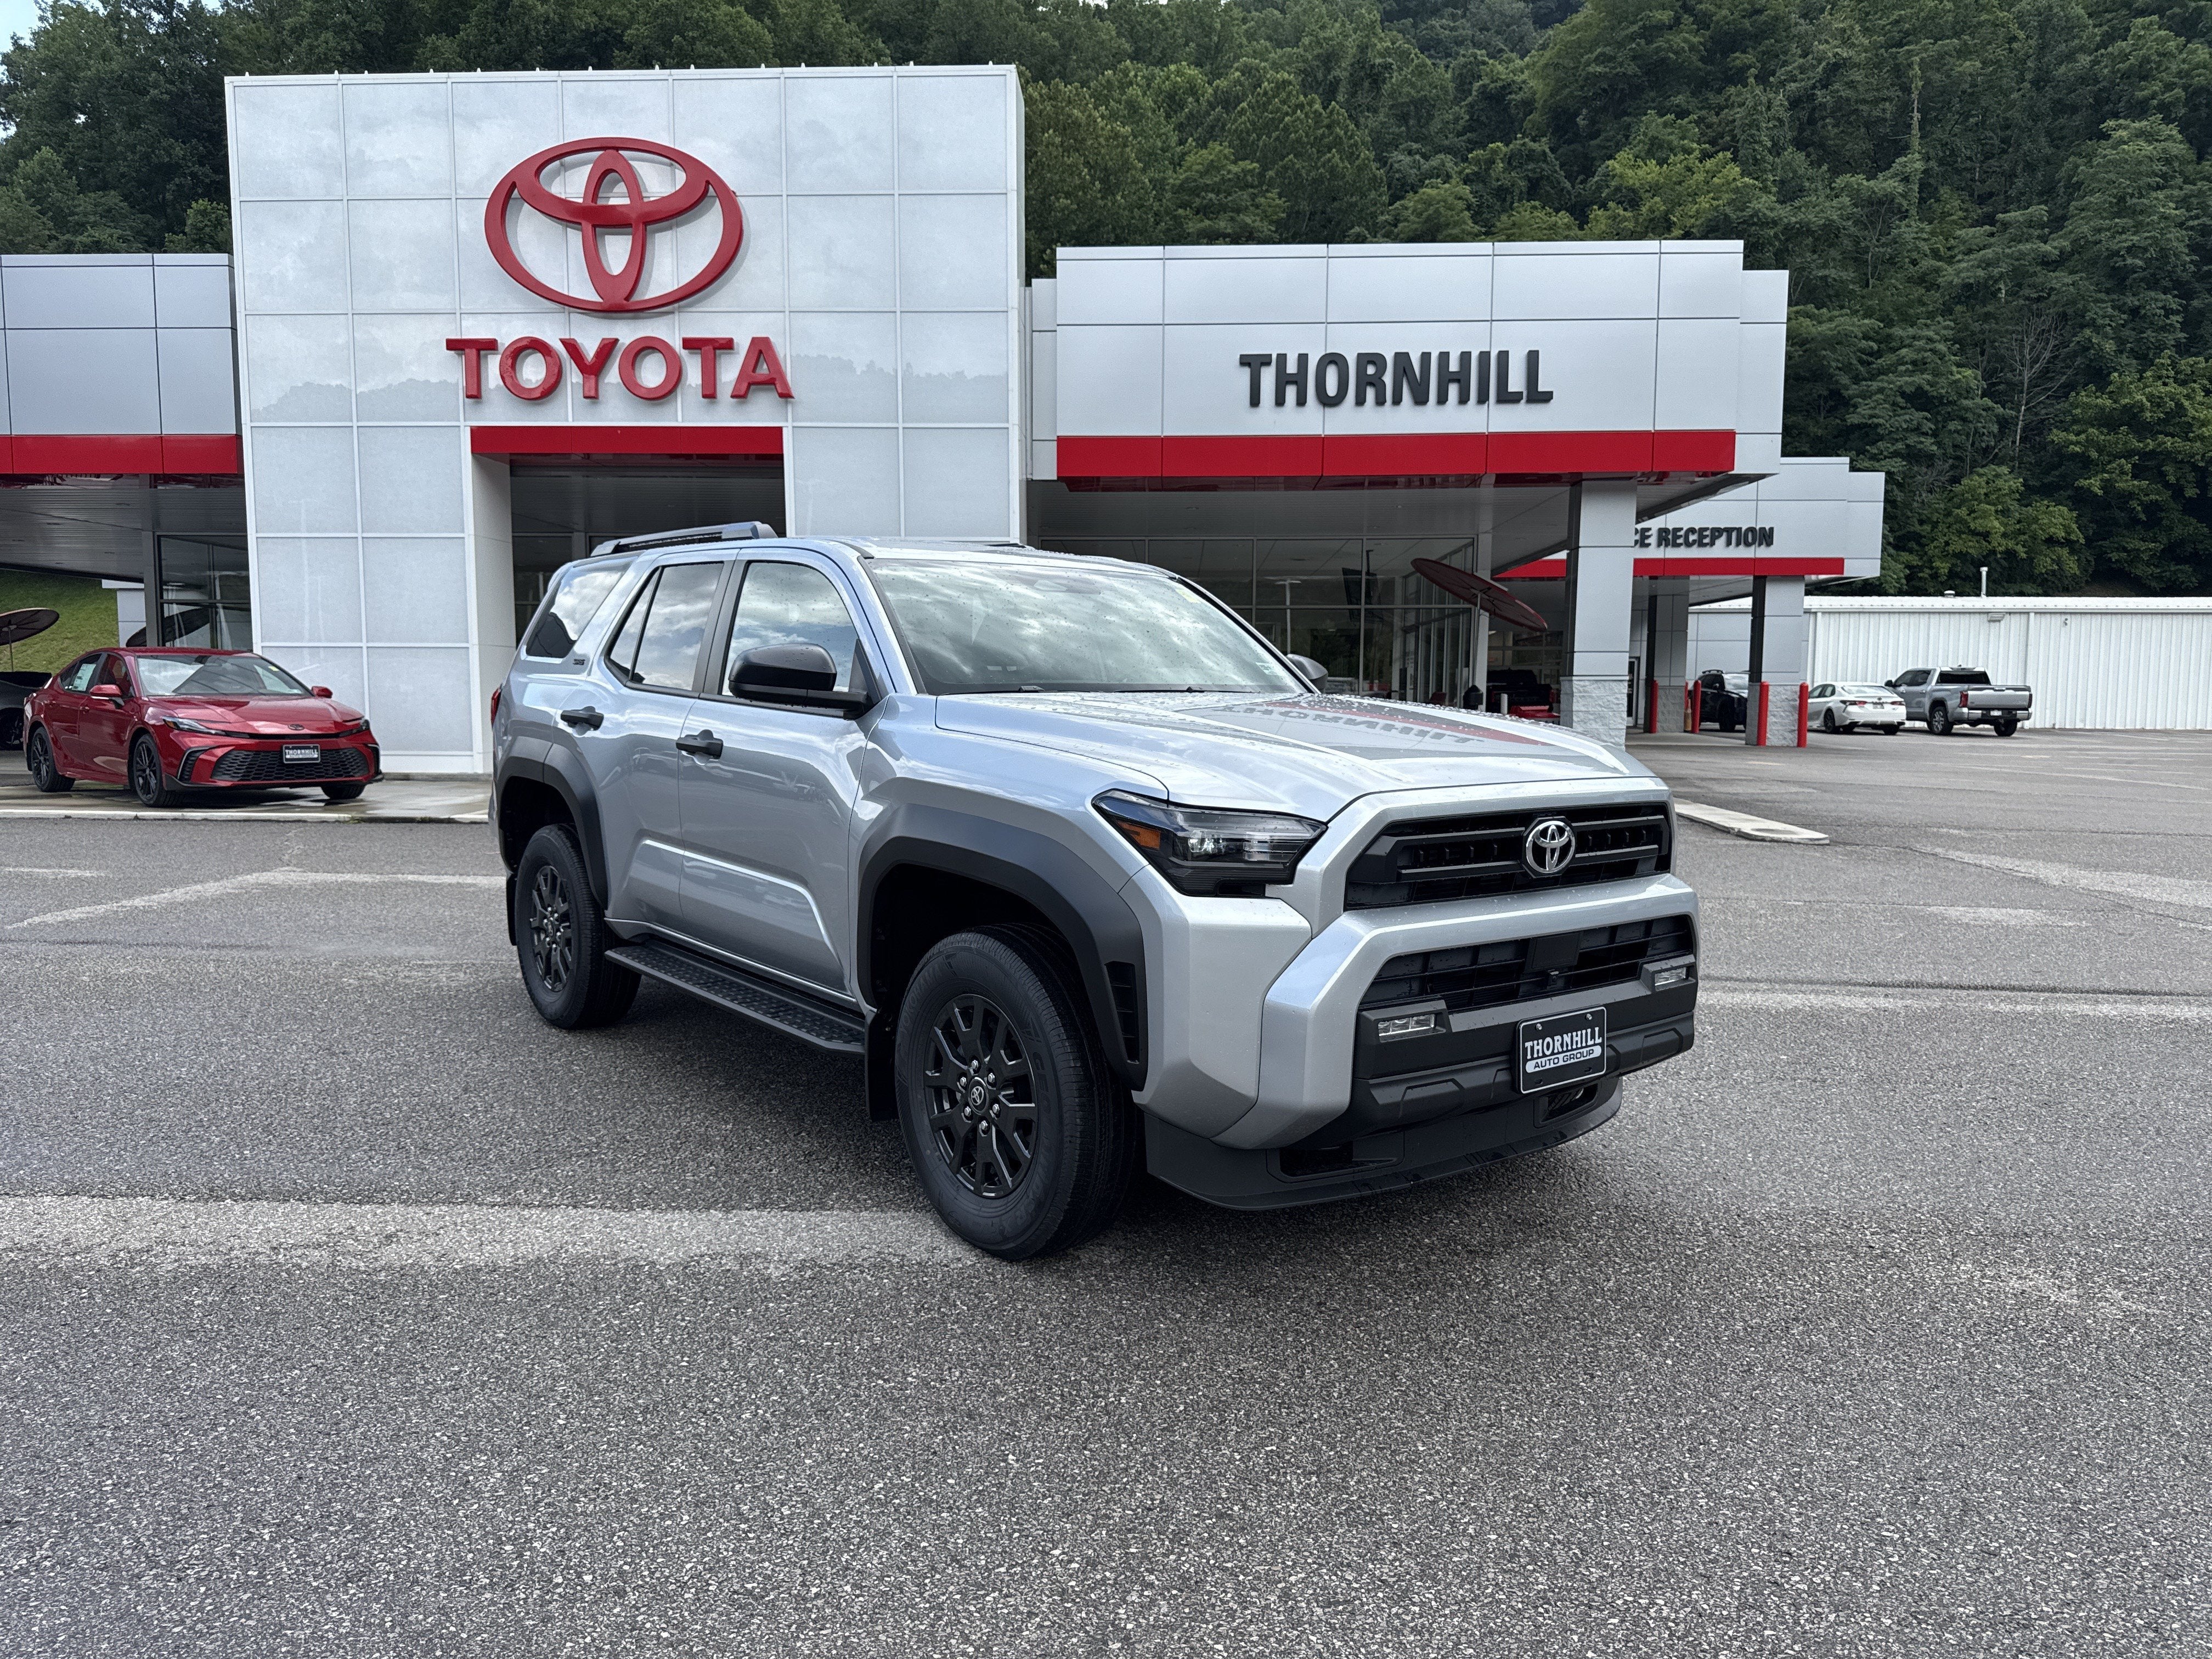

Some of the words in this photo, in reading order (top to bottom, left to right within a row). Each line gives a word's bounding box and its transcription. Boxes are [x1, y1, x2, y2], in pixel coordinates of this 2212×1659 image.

[445, 336, 795, 400] TOYOTA
[1239, 350, 1554, 408] THORNHILL
[1657, 527, 1774, 548] RECEPTION
[1525, 1026, 1602, 1059] THORNHILL
[1533, 1057, 1560, 1070] AUTO
[1562, 1048, 1594, 1063] GROUP
